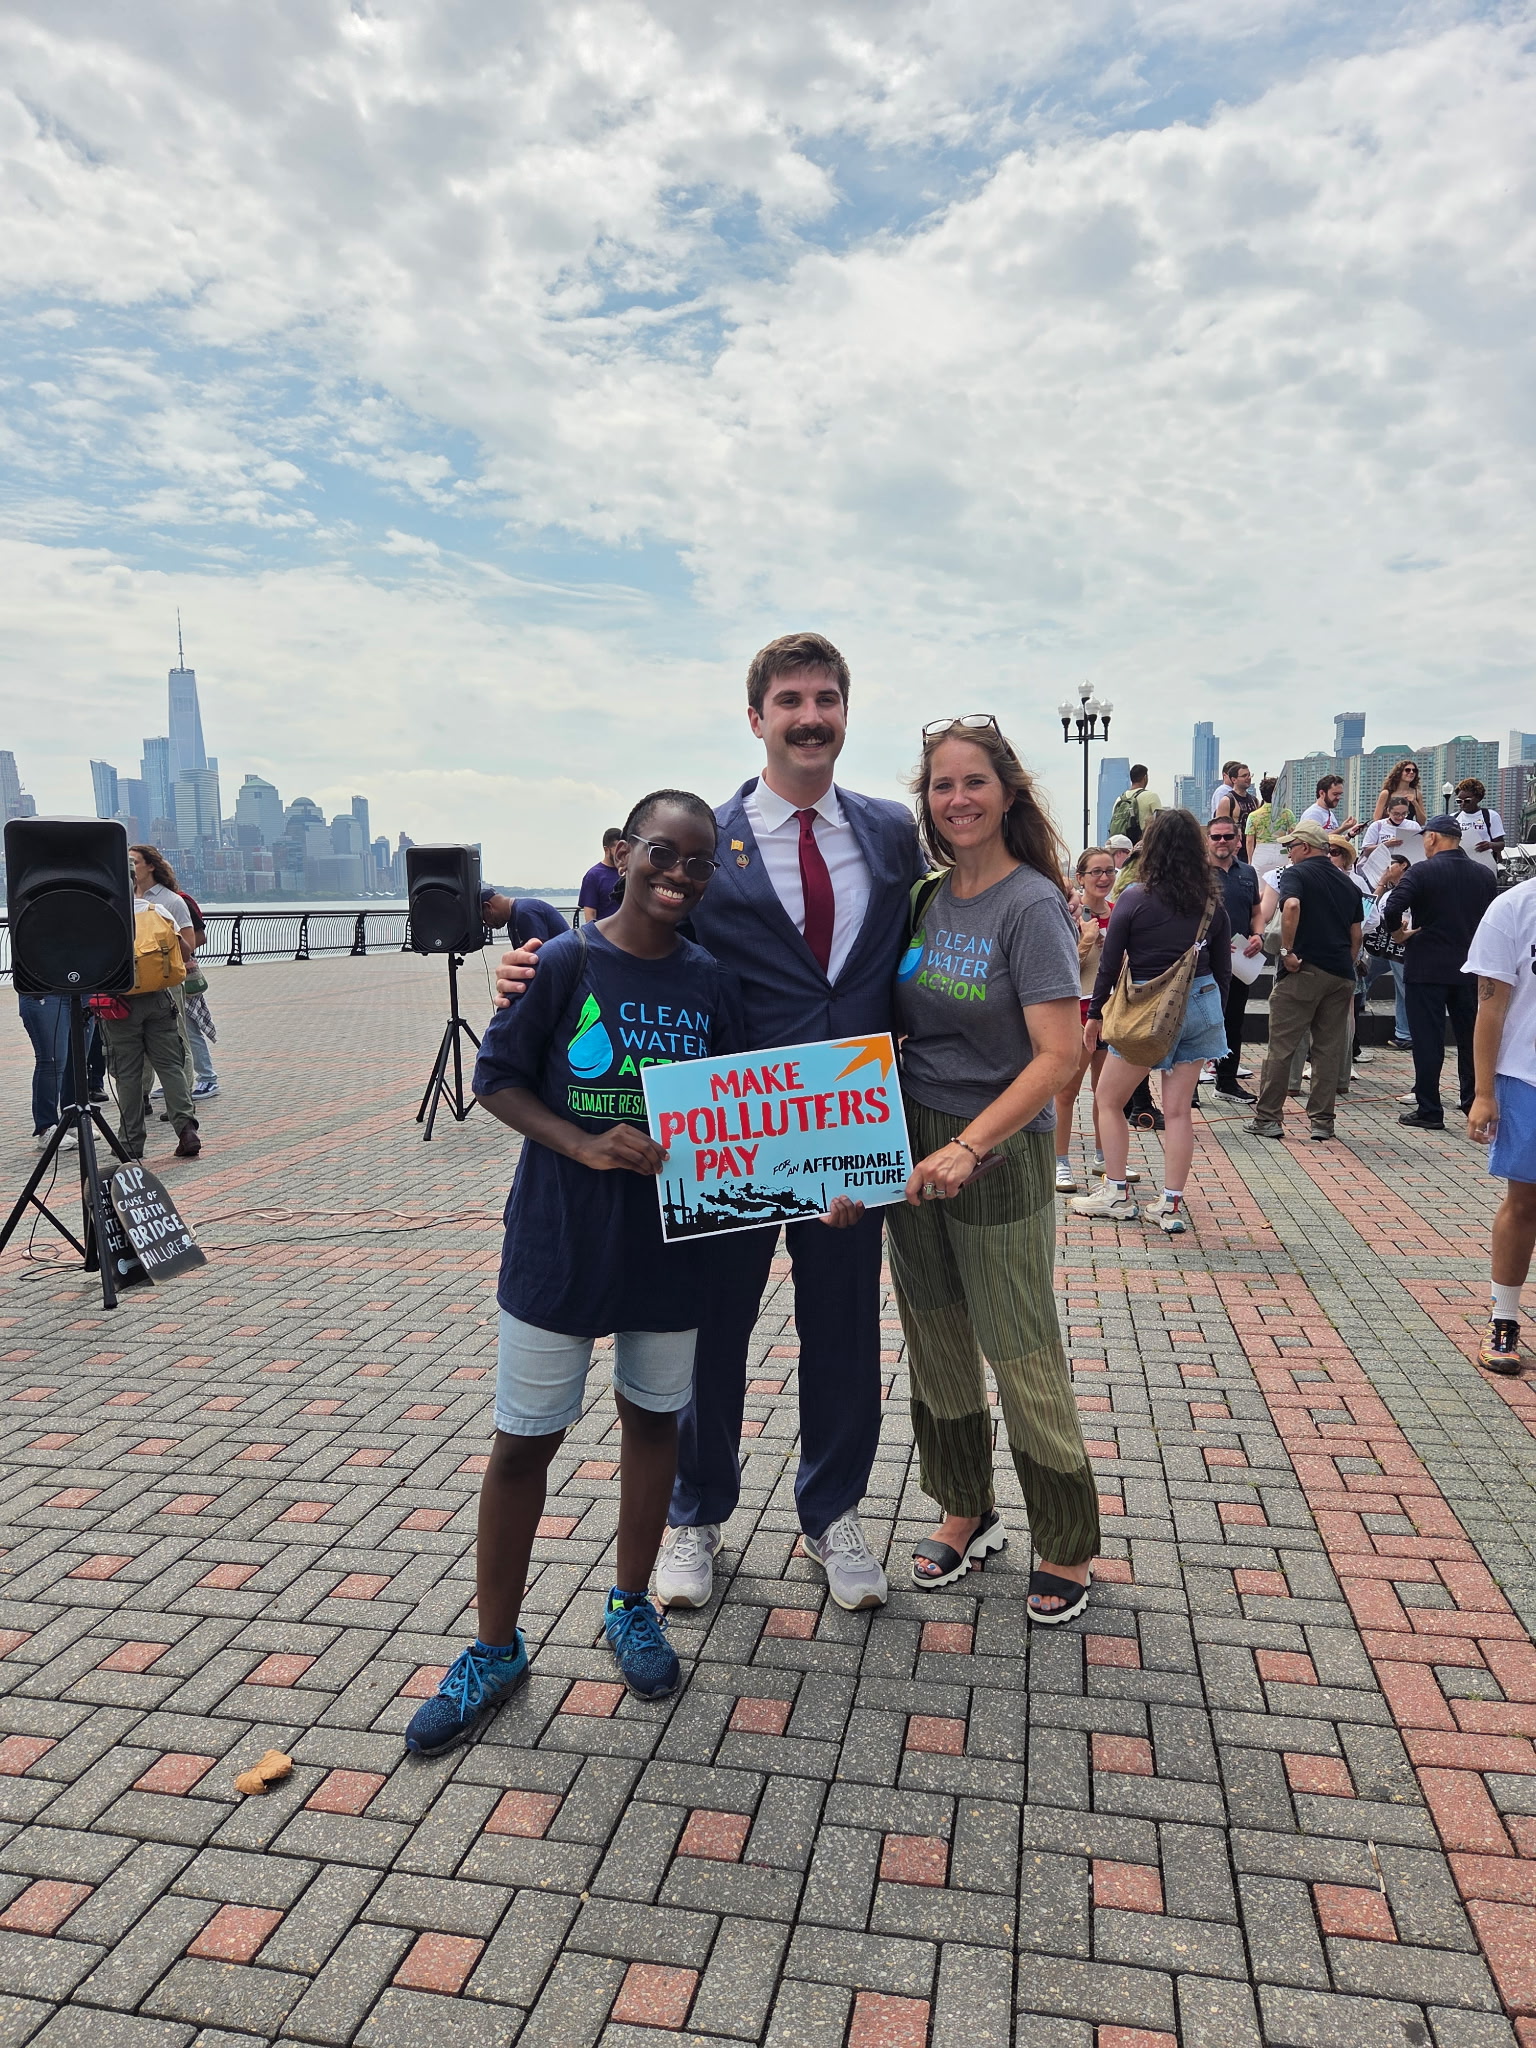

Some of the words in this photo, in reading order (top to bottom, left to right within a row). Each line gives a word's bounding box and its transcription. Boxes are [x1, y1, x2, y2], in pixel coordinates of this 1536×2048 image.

[936, 929, 993, 956] CLEAN
[927, 950, 988, 979] WATER
[917, 970, 986, 1001] ACTION
[620, 1002, 710, 1035] CLEAN
[619, 1027, 708, 1058] WATER
[709, 1061, 804, 1102] MAKE
[571, 1090, 616, 1114] CLIMATE
[658, 1086, 890, 1150] POLLUTERS
[695, 1143, 760, 1182] PAY
[773, 1158, 791, 1175] FOR
[787, 1163, 799, 1178] AN
[802, 1150, 905, 1174] AFFORDABLE
[844, 1168, 906, 1187] FUTURE
[117, 1196, 145, 1211] CAUSE
[147, 1190, 158, 1201] OF
[130, 1202, 167, 1225] DEATH
[128, 1213, 184, 1249] BRIDGE
[140, 1238, 185, 1270] FAILURE
